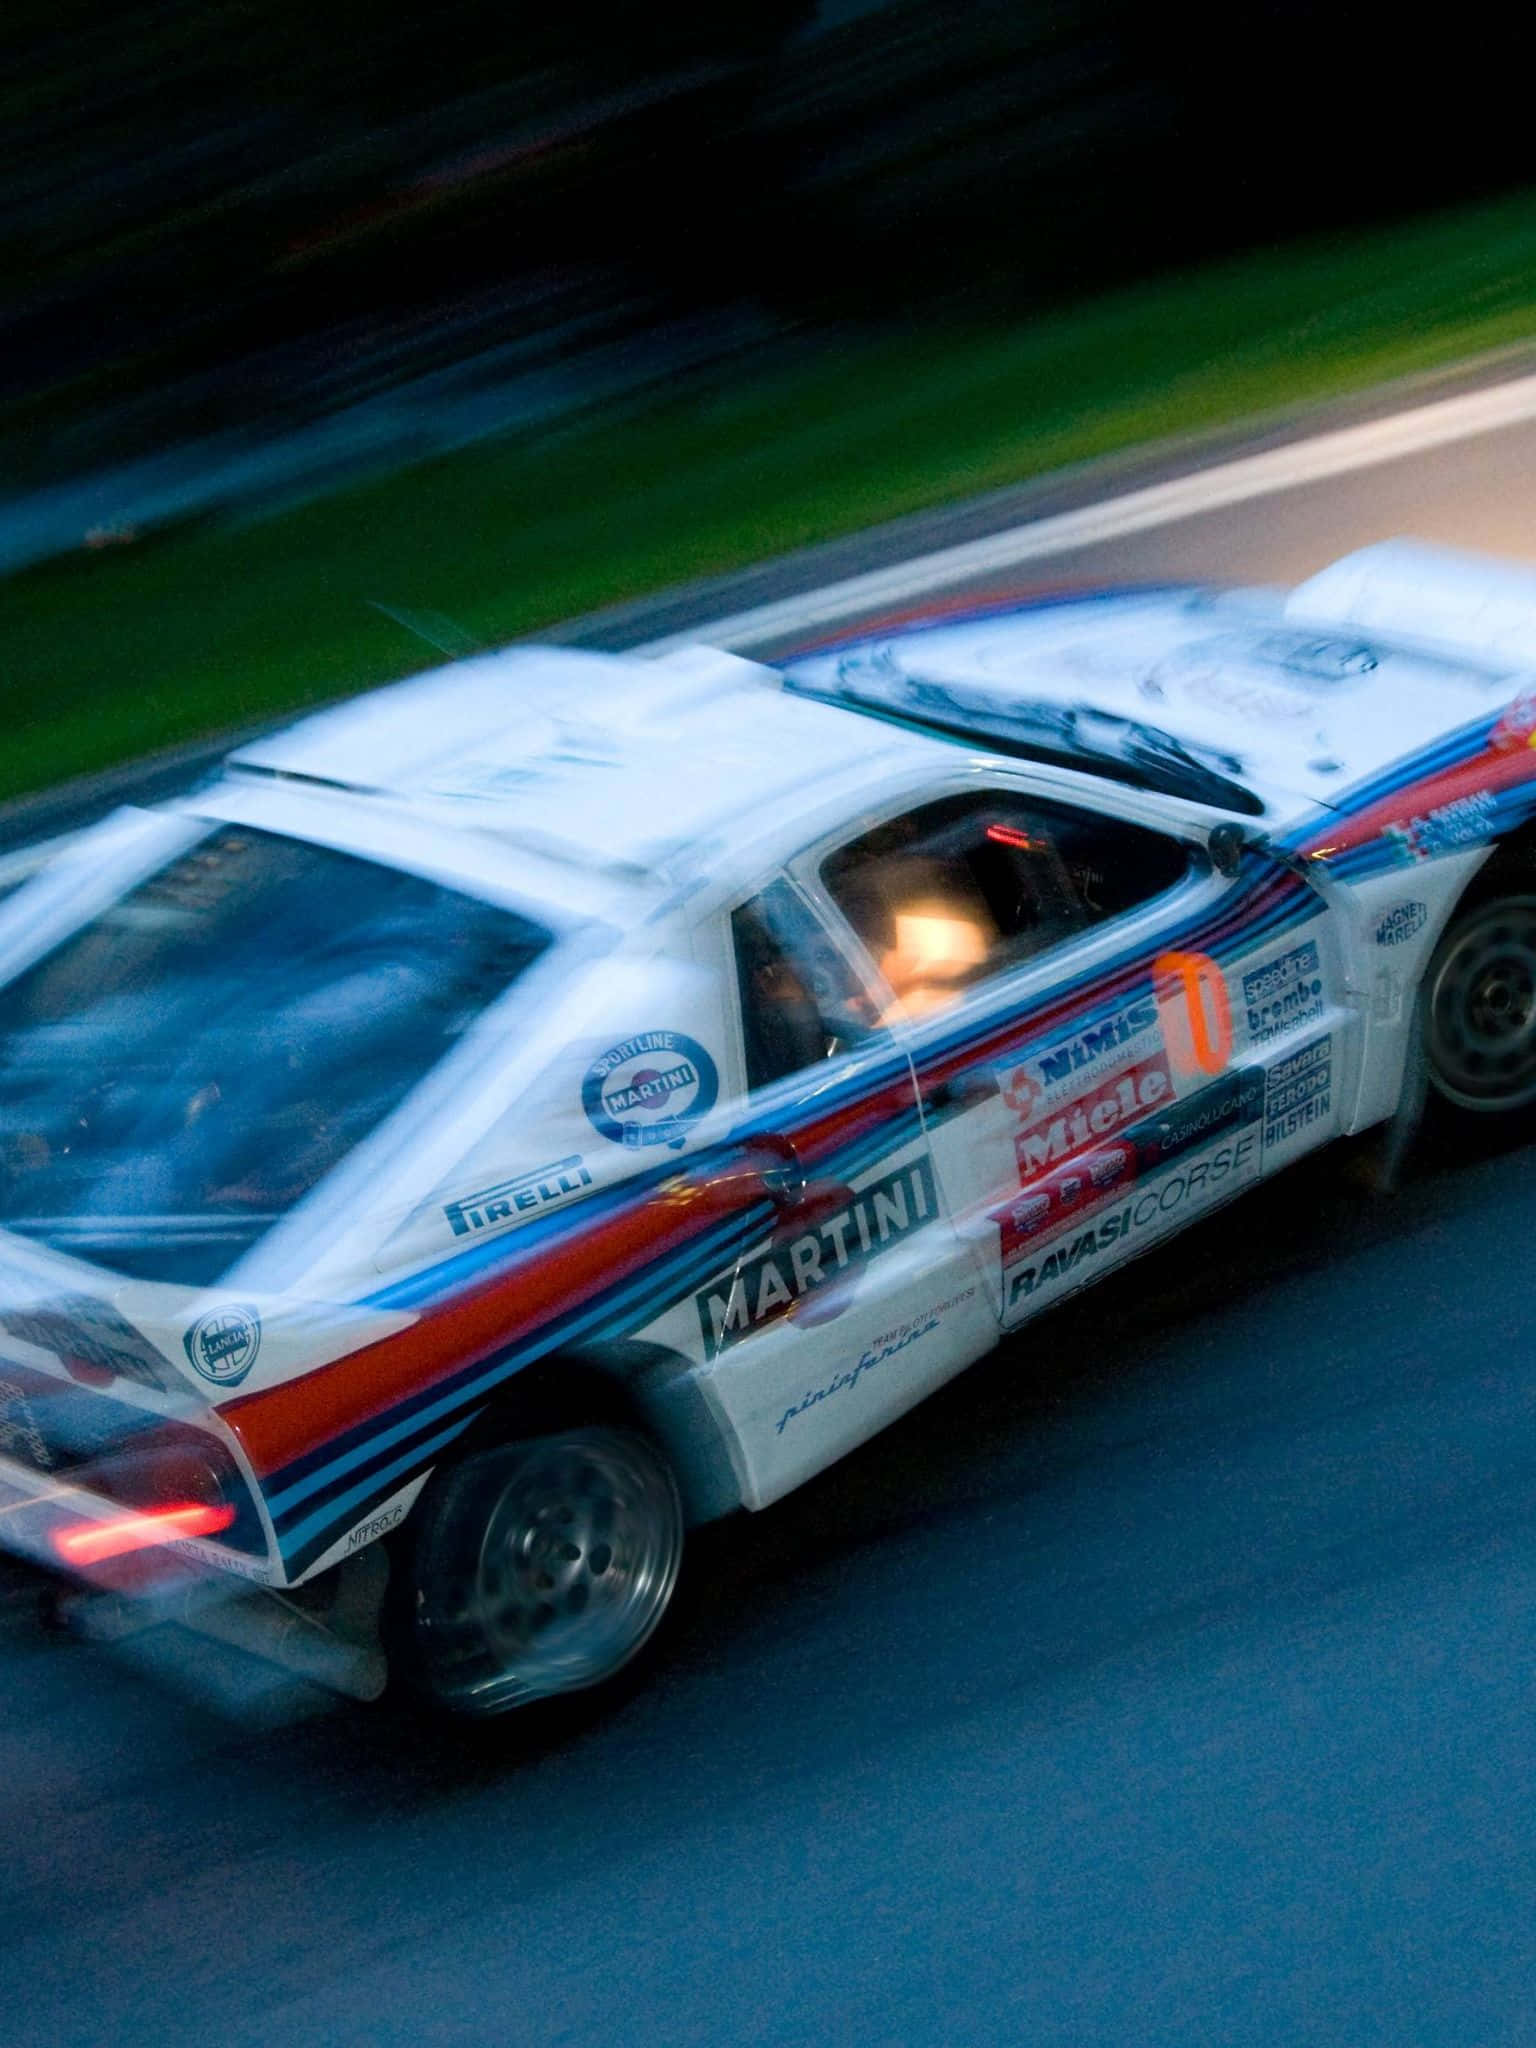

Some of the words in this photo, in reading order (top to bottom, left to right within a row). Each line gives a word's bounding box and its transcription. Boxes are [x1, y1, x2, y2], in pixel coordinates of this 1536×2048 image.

[1247, 978, 1322, 1030] brembo
[594, 1032, 674, 1077] SPORTLINE
[608, 1065, 691, 1112] MARTINI
[1018, 1070, 1168, 1177] Miele
[1265, 1091, 1330, 1149] BILSTEIN
[442, 1154, 593, 1237] PIRELLI
[706, 1168, 930, 1332] MARTINI
[207, 1330, 244, 1356] LANCIA
[775, 1318, 940, 1434] pininfarina
